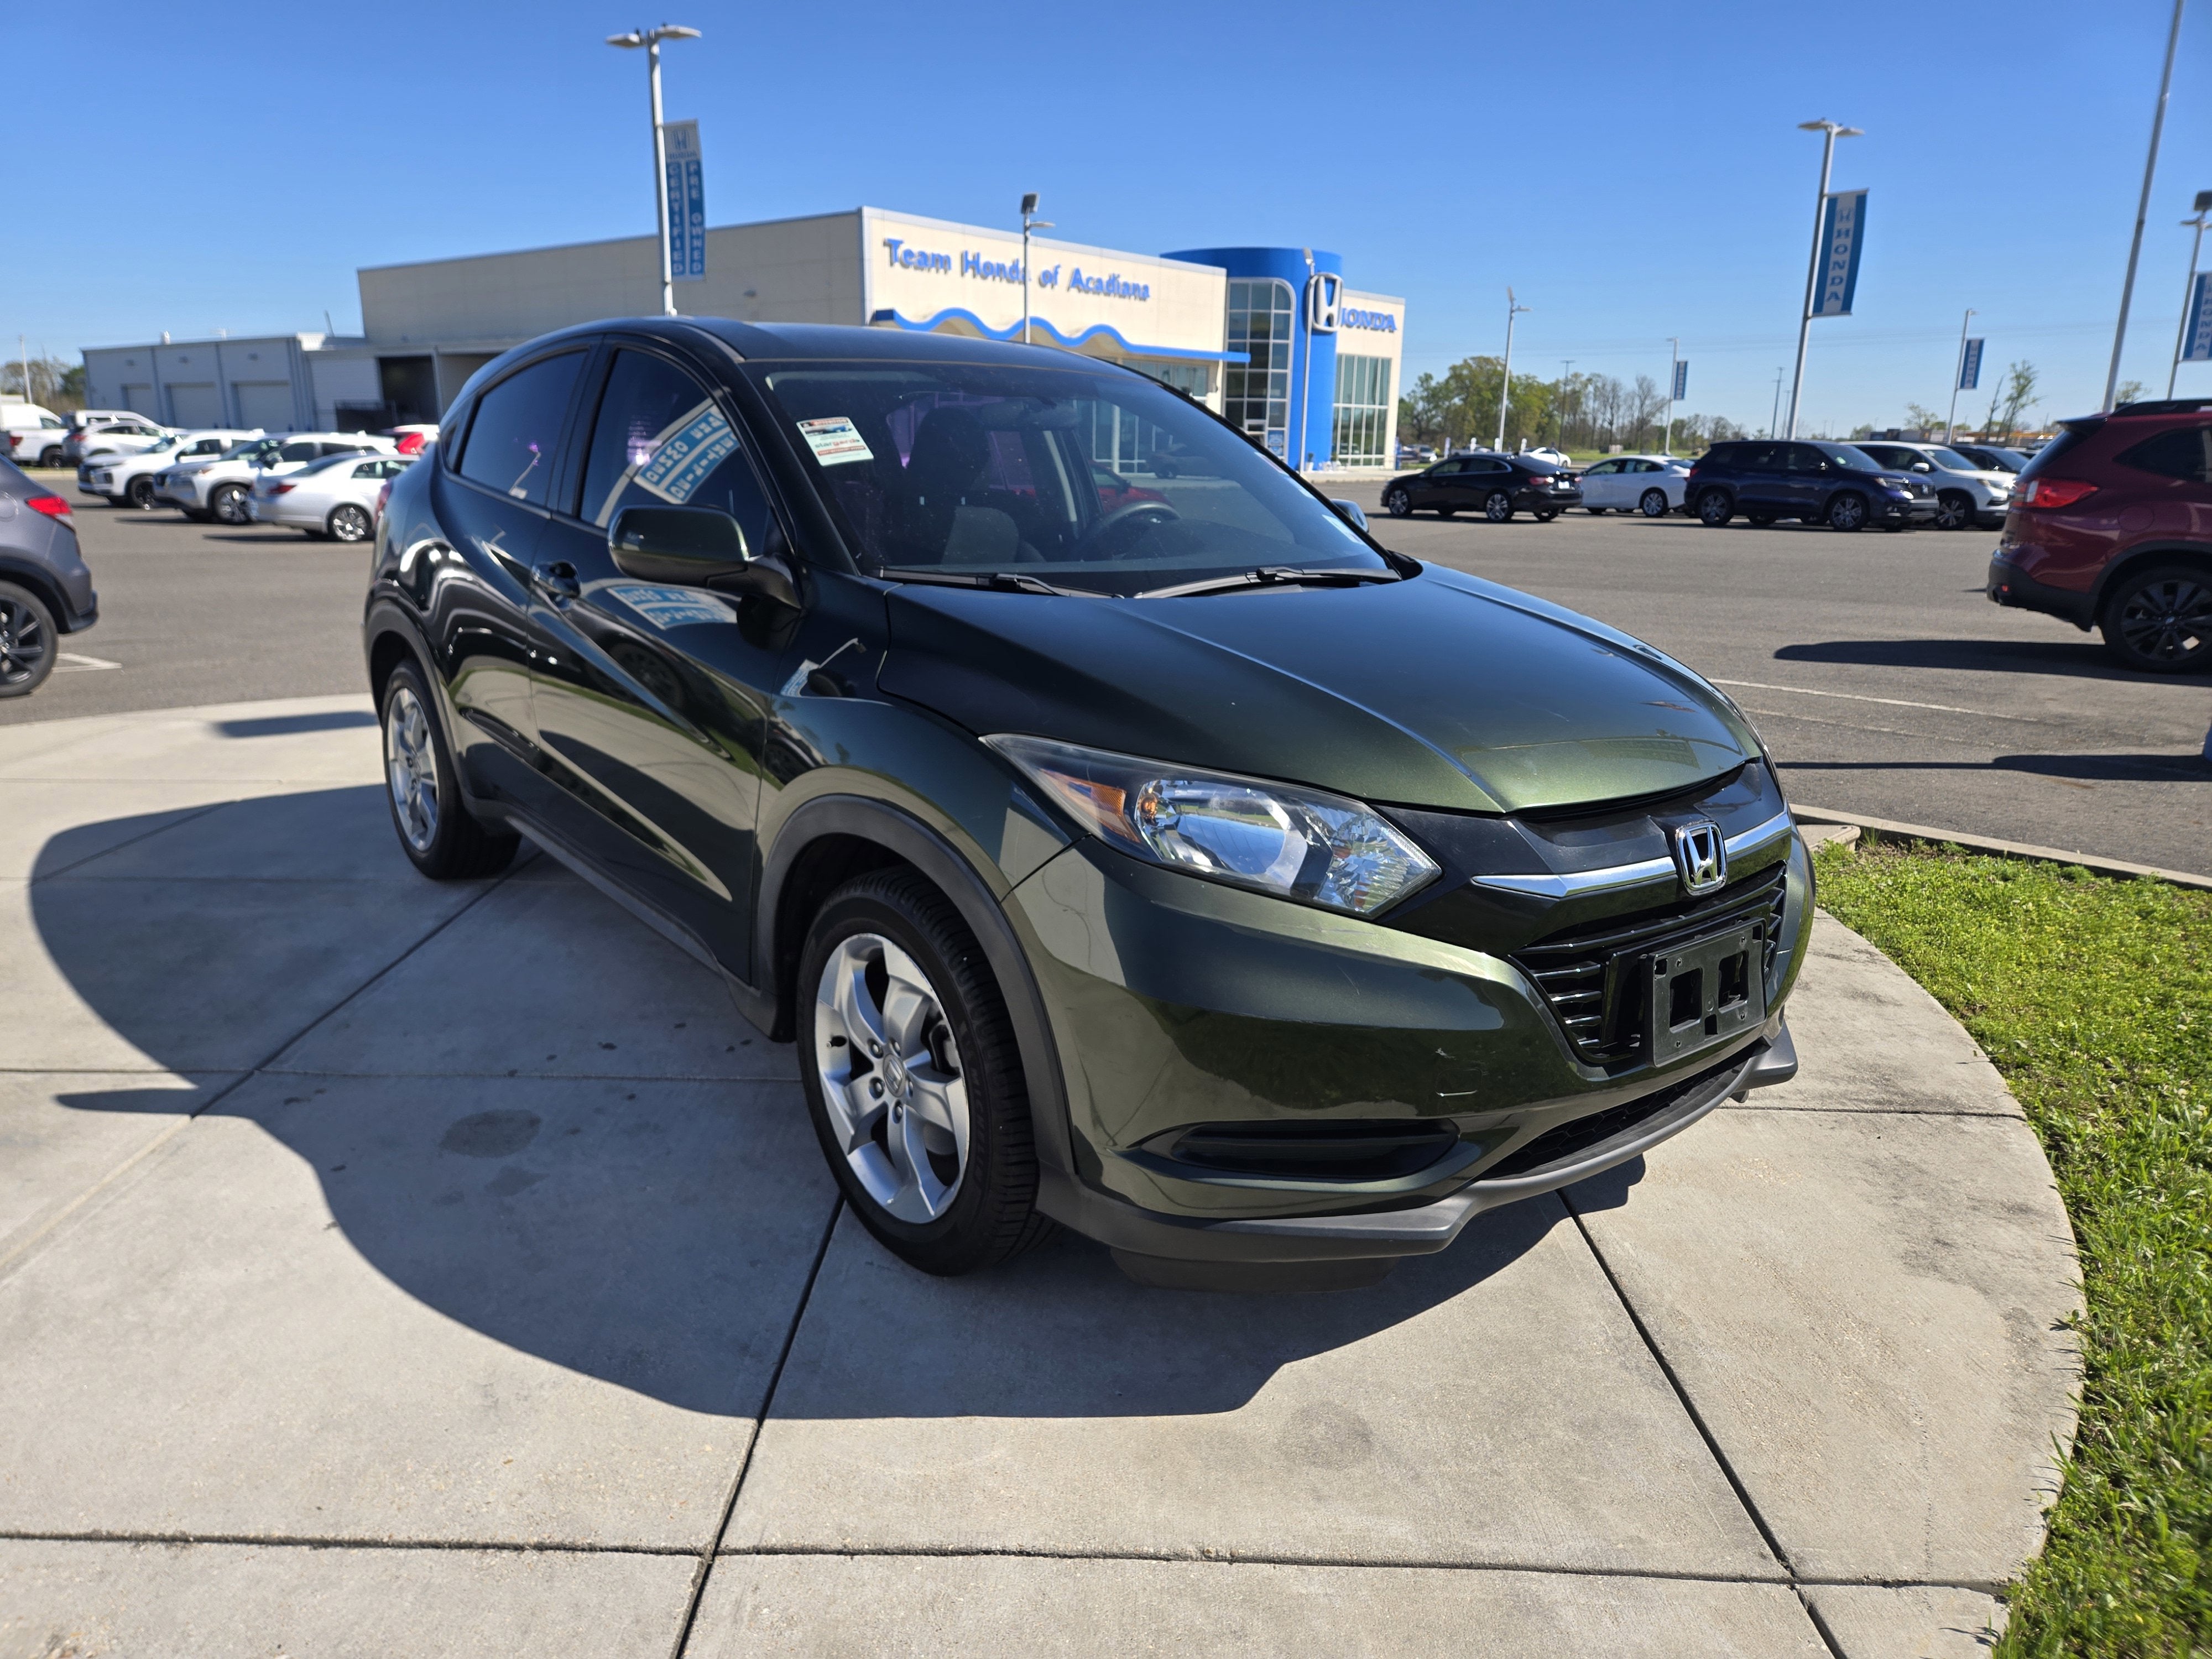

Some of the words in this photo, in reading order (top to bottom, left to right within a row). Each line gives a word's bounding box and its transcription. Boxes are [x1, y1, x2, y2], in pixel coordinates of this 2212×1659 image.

[691, 163, 700, 200] PRE
[669, 164, 684, 273] CERTIFIED
[691, 213, 703, 272] OWNED
[885, 238, 952, 272] Team
[1040, 264, 1061, 288] of
[1070, 268, 1150, 300] Acadiana
[1826, 228, 1851, 302] HONDA
